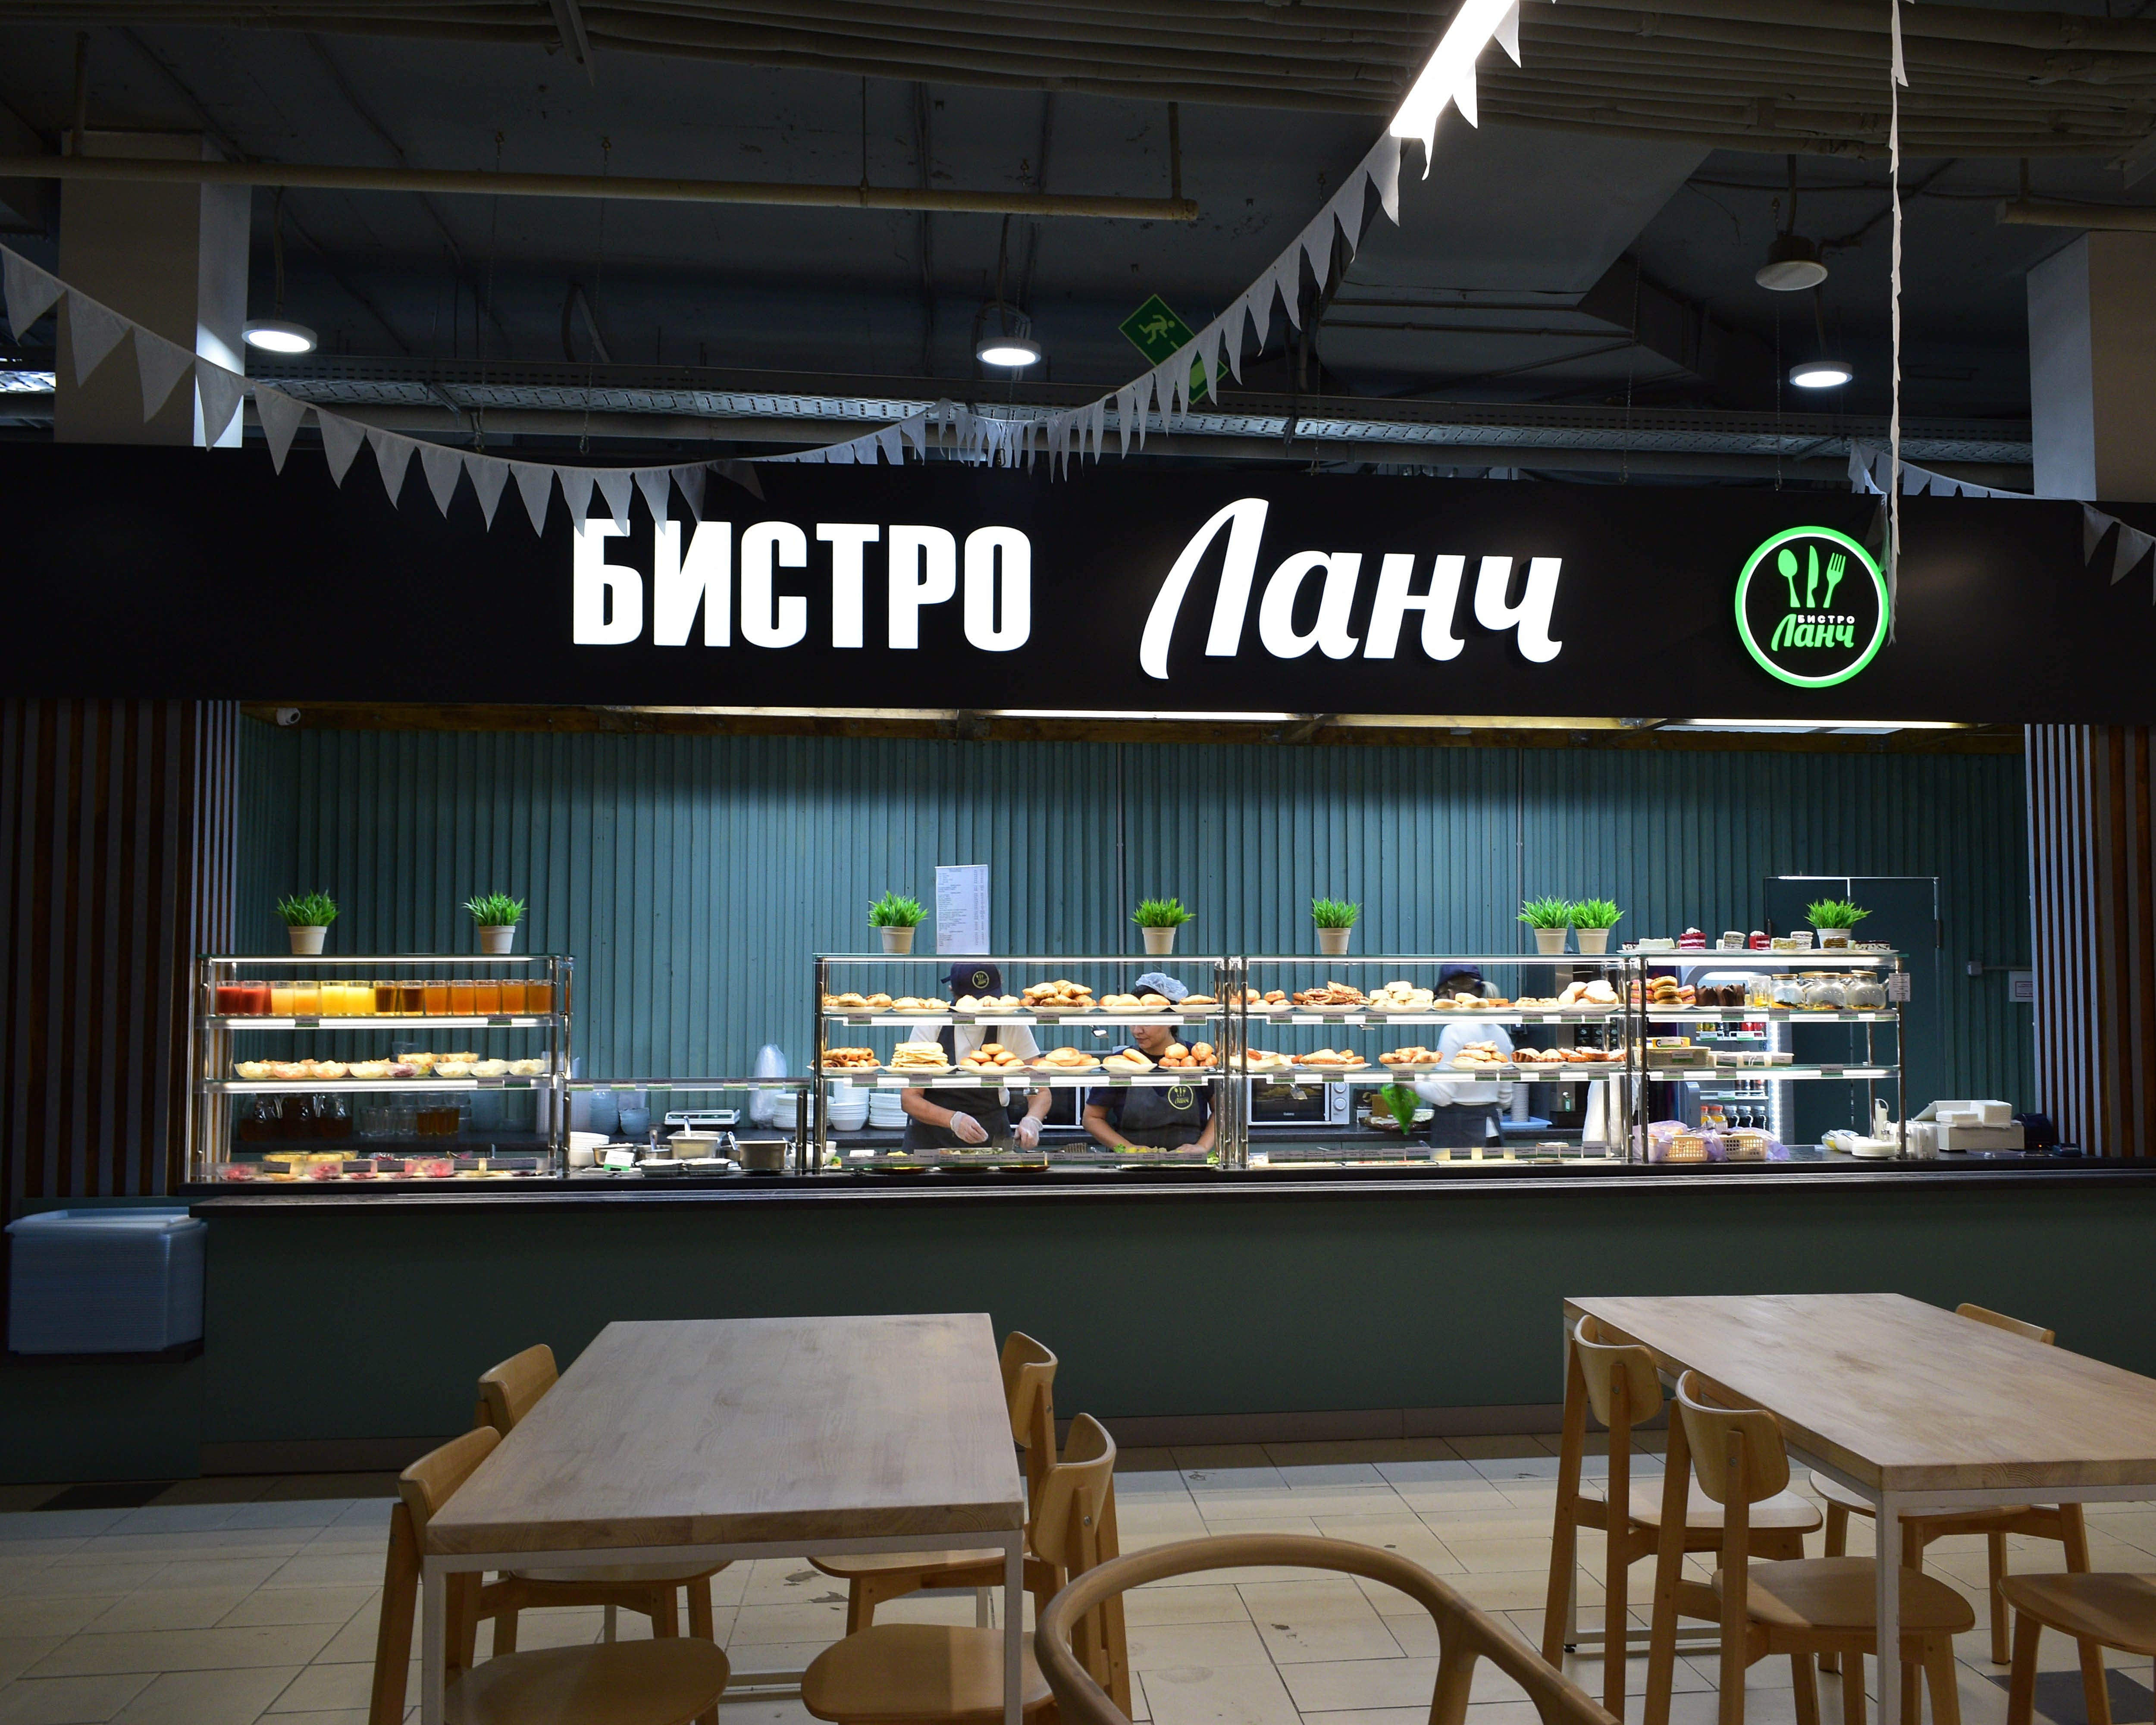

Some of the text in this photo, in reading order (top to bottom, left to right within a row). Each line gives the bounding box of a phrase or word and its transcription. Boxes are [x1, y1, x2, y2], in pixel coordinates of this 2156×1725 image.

[573, 498, 1562, 679] БИСТРО Ланч
[1771, 614, 1854, 651] Ланч
[1798, 615, 1855, 624] БИСТРО
